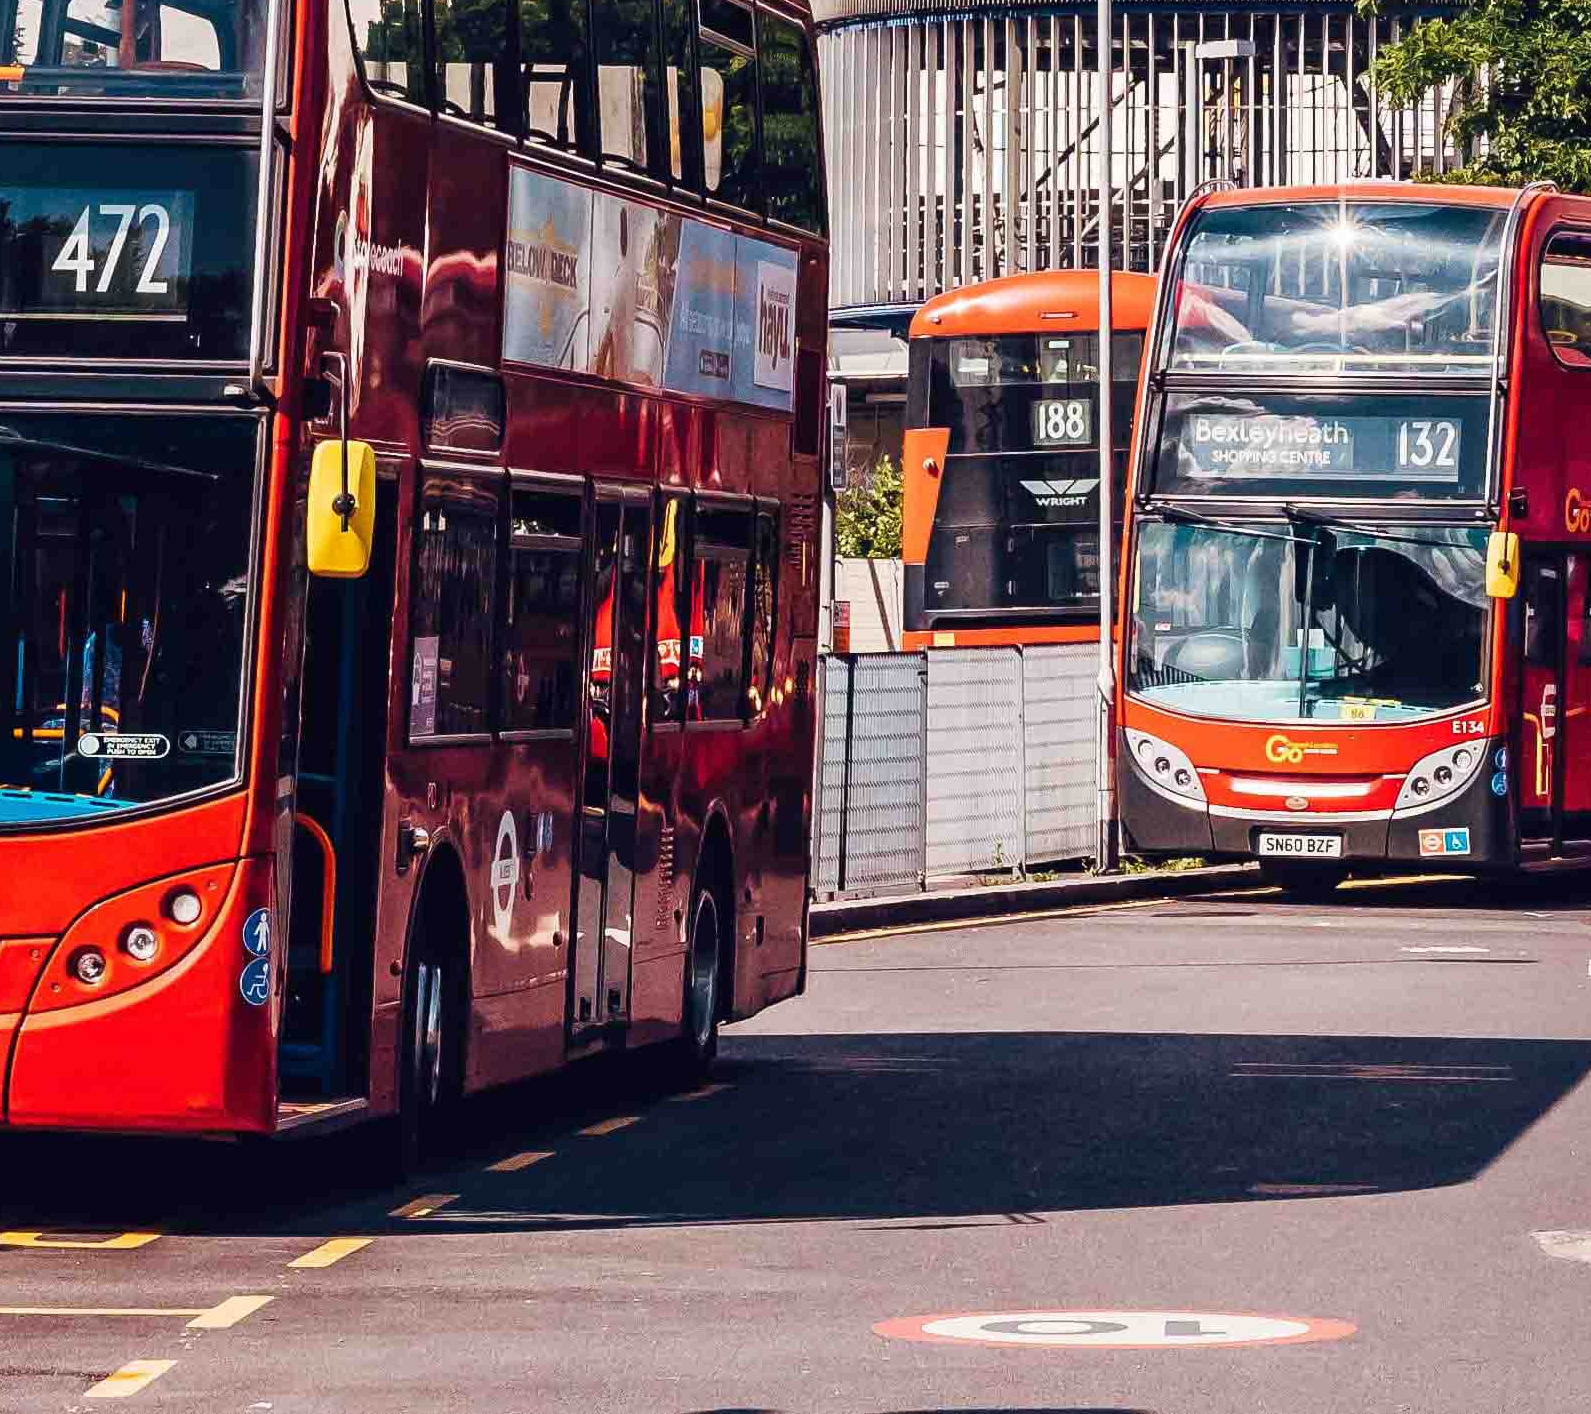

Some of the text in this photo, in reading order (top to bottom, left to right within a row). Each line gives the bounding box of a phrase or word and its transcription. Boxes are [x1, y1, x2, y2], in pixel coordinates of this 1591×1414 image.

[50, 203, 170, 293] 472
[553, 252, 578, 289] DECK
[1038, 401, 1085, 440] 188
[1194, 419, 1456, 466] Bexleyheath 132
[1211, 450, 1331, 464] SHOPPING CENTRE
[1035, 496, 1088, 507] WRIGHT
[1565, 487, 1590, 533] Go
[1452, 720, 1484, 734] E134
[1265, 734, 1304, 764] Go
[1265, 837, 1335, 854] SN60 BZF
